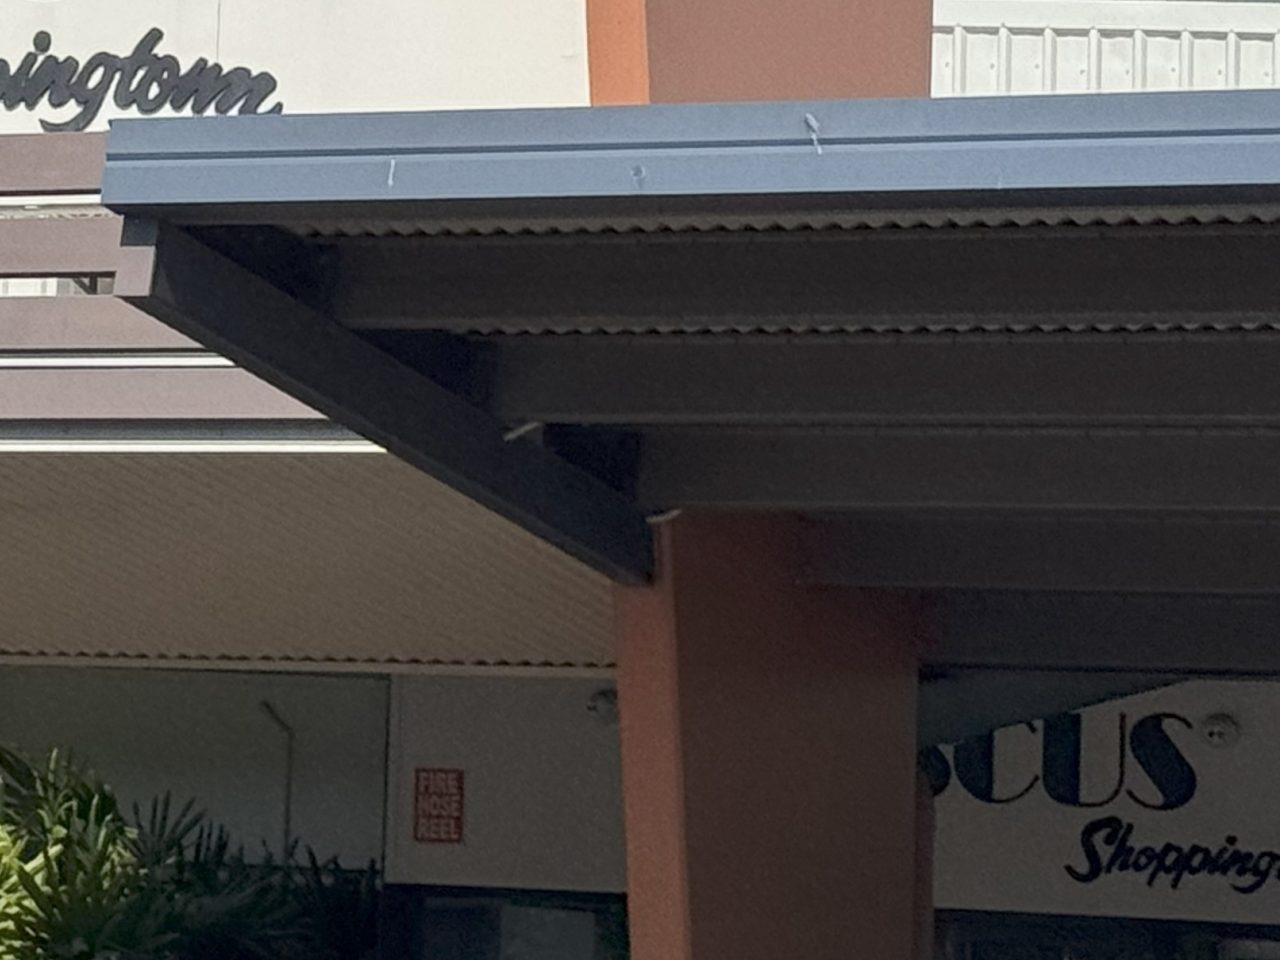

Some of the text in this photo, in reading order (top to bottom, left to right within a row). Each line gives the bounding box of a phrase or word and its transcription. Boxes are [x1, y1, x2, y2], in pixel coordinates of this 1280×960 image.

[418, 771, 459, 794] FIRE
[417, 795, 461, 816] HOSE
[417, 817, 459, 839] REEL
[1064, 815, 1280, 894] Shopping
